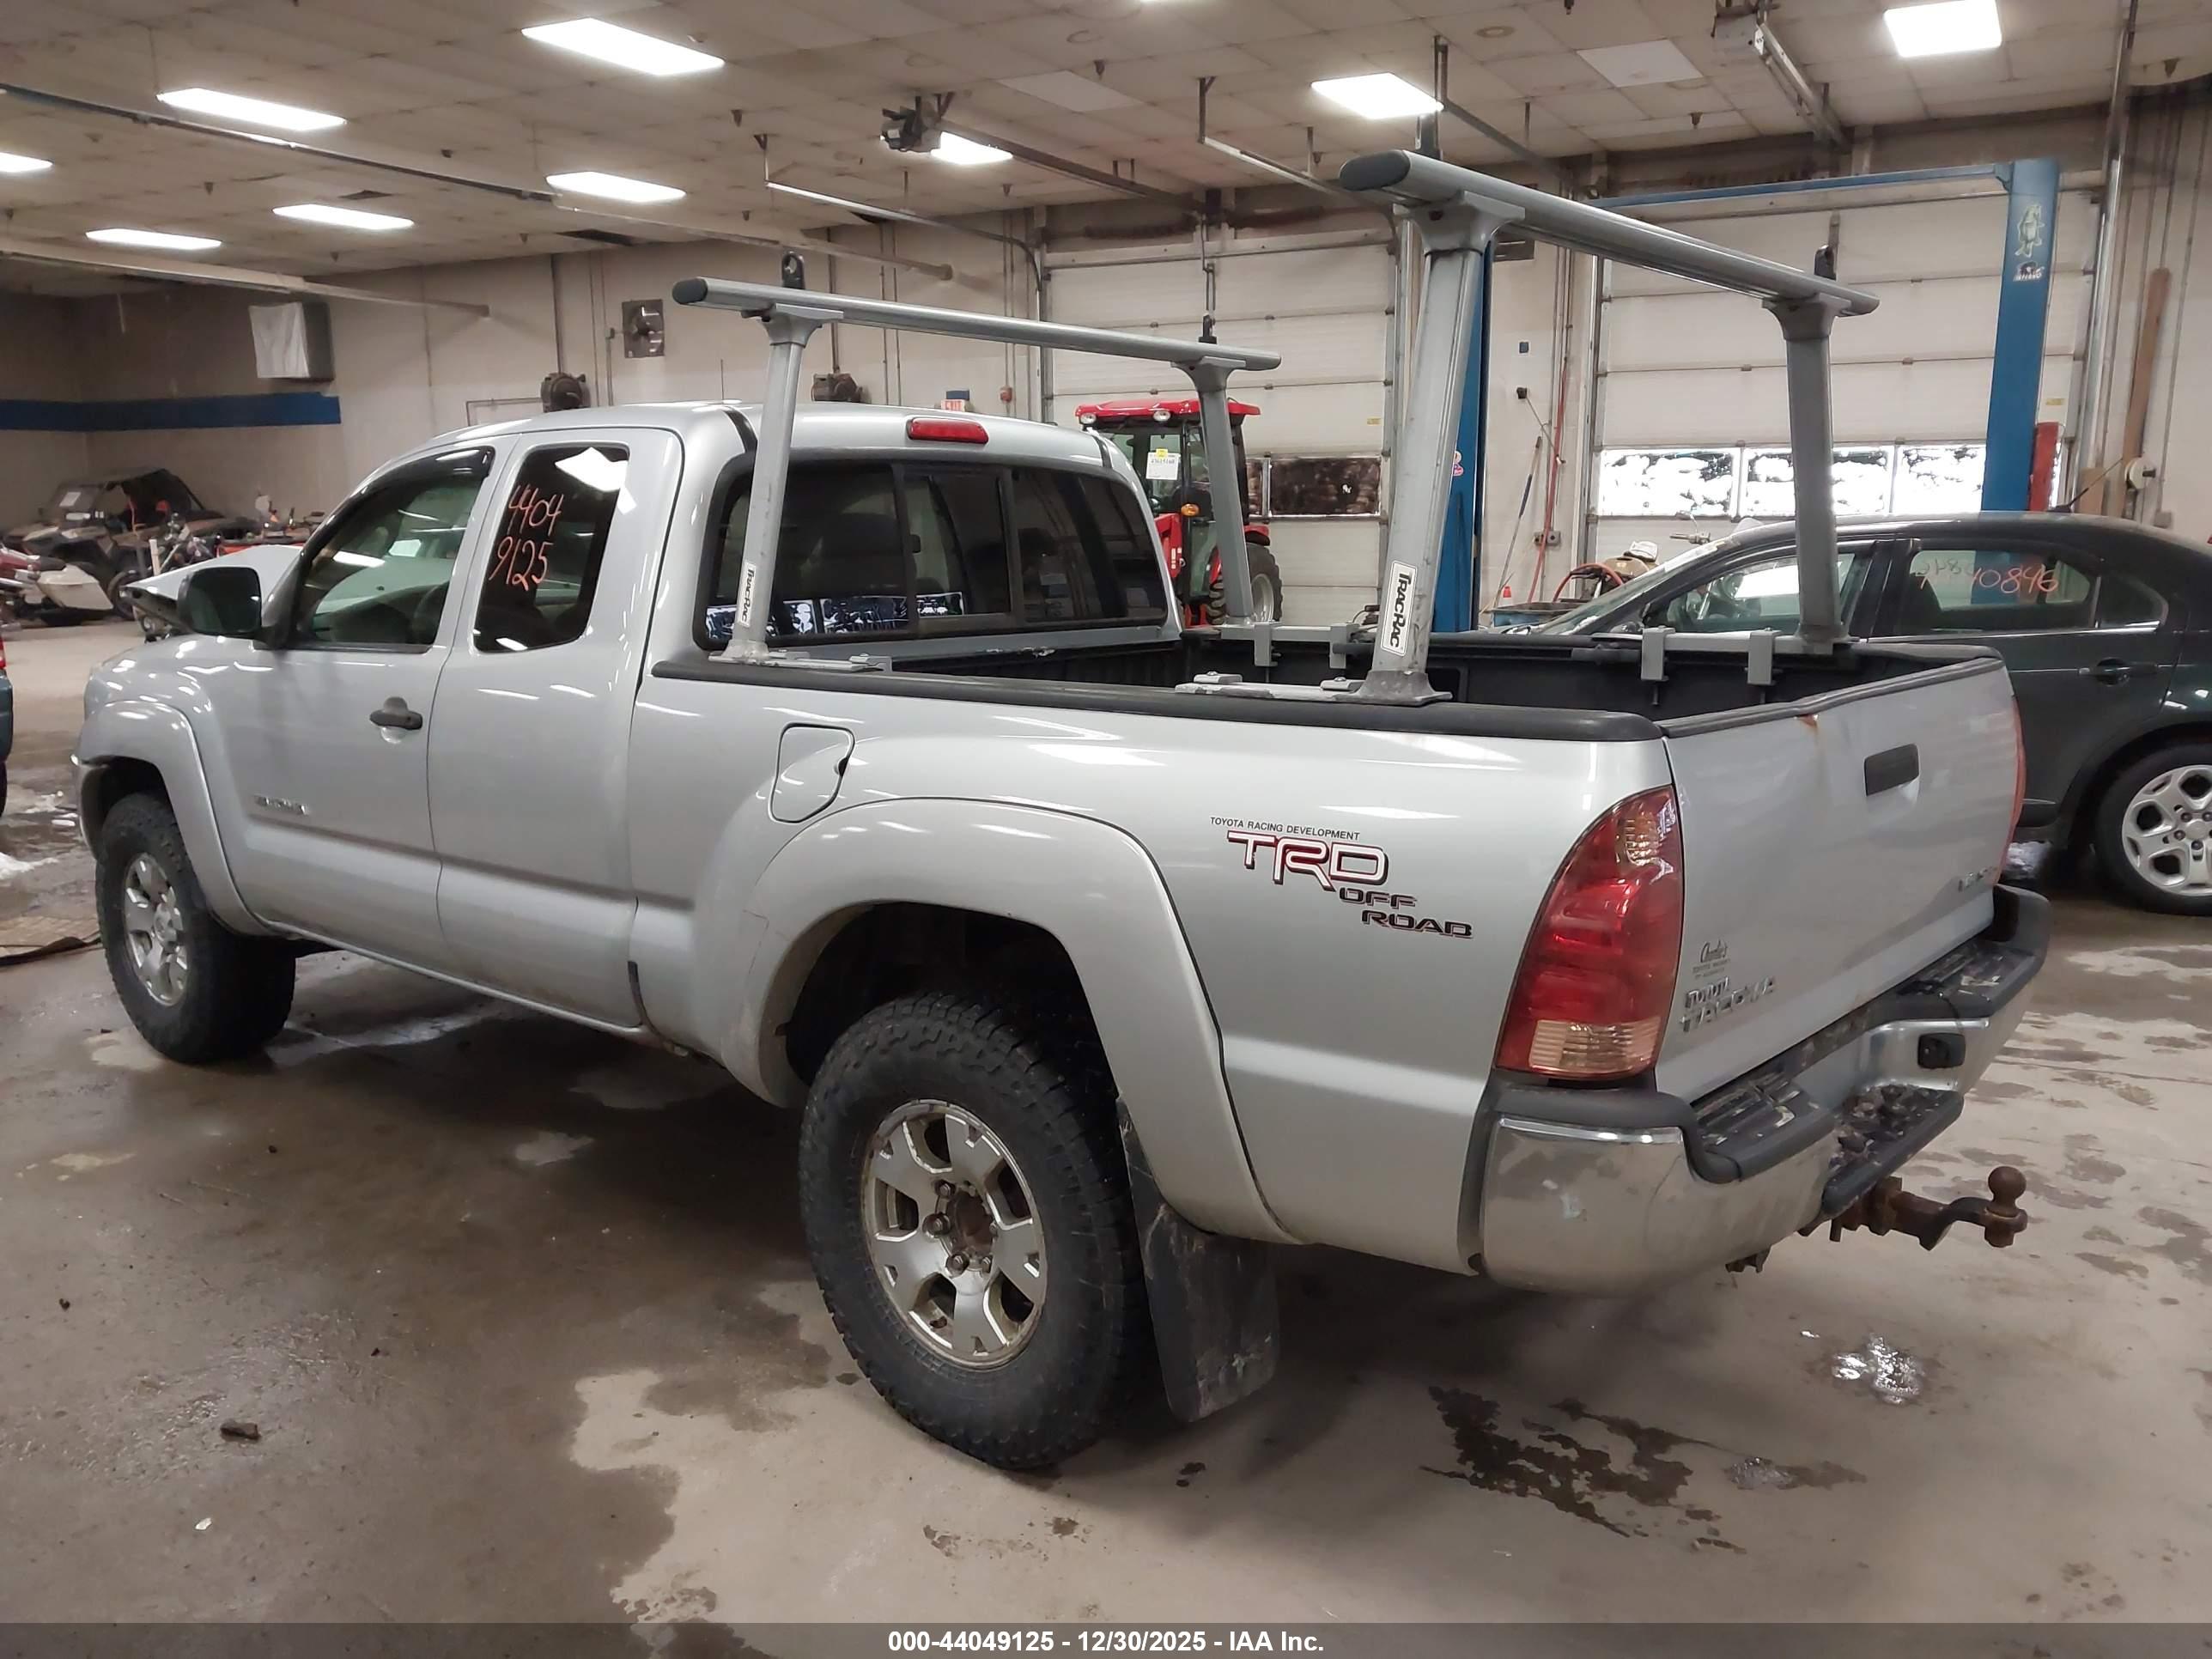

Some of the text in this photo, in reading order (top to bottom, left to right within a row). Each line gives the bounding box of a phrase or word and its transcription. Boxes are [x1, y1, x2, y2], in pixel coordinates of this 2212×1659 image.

[507, 483, 563, 536] 4404
[489, 535, 553, 592] 9125
[1210, 817, 1360, 841] TOYOTA RACING DEVELOPMENT
[1226, 830, 1389, 892] TRD
[1339, 887, 1417, 909] OFF
[1361, 909, 1474, 939] ROAD
